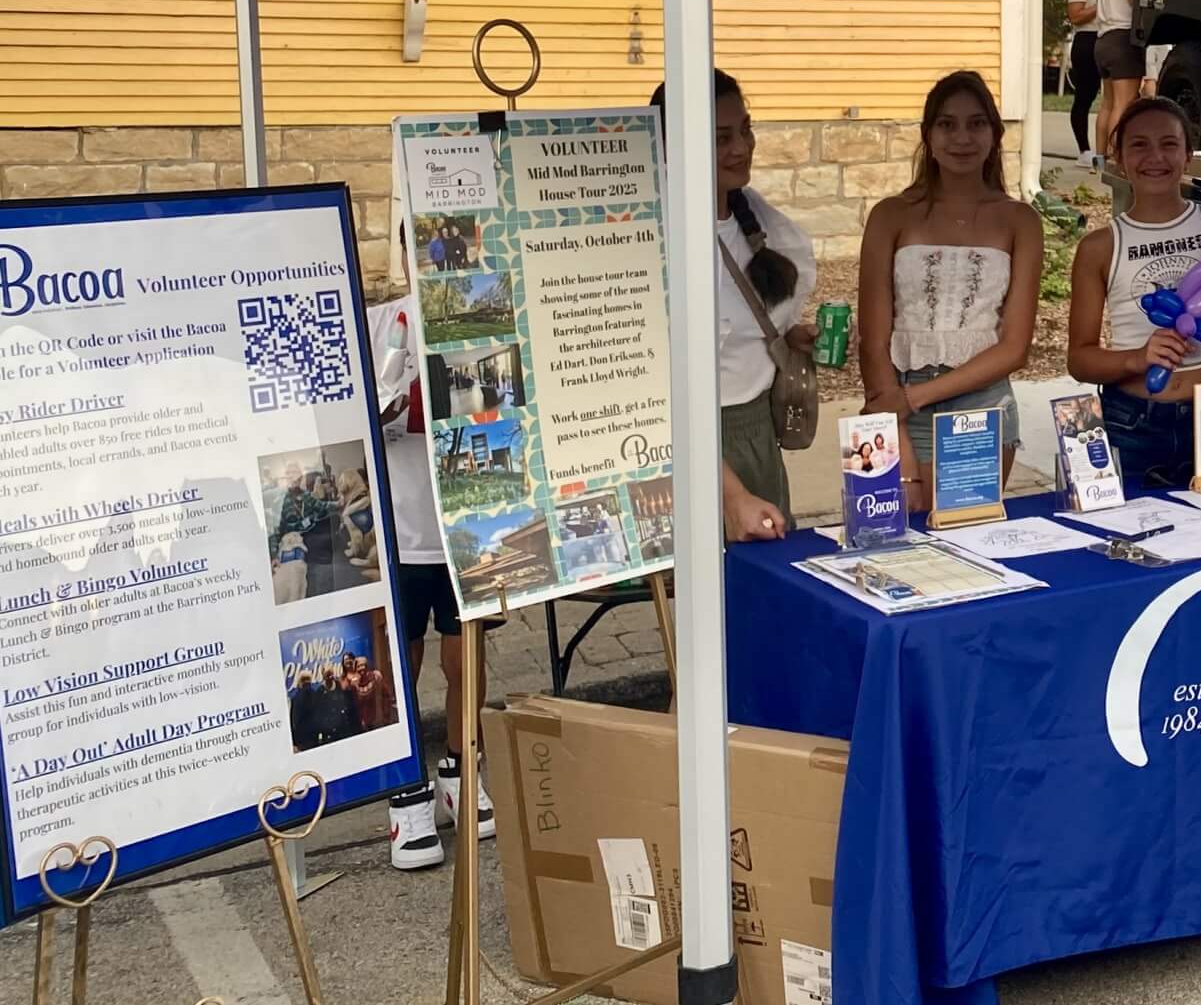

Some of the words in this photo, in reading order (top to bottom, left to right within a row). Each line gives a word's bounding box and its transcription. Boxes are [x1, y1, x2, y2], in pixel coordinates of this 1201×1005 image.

[425, 146, 480, 155] VOLUNTEER
[541, 139, 628, 157] VOLUNTEER
[528, 168, 550, 180] Mid
[553, 165, 577, 179] Mod
[580, 163, 645, 178] Barrington
[426, 189, 450, 200] MID
[458, 187, 486, 197] MOD
[539, 188, 576, 202] House
[578, 186, 607, 199] Tour
[609, 183, 638, 196] 2025
[525, 237, 583, 253] Saturday,
[585, 232, 632, 246] October
[635, 229, 654, 242] 4th
[0, 244, 125, 317] Bacoa
[137, 273, 226, 295] Volunteer
[231, 261, 345, 287] Opportunities
[540, 277, 560, 288] Join
[561, 275, 576, 285] the
[577, 274, 604, 284] house
[605, 272, 624, 282] tour
[626, 269, 648, 279] team
[540, 293, 579, 305] showing
[579, 289, 602, 299] some
[604, 286, 615, 296] of
[614, 286, 628, 296] the
[630, 283, 650, 293] most
[553, 306, 603, 320] fascinating
[604, 303, 632, 314] homes
[633, 301, 642, 309] in
[10, 342, 34, 357] the
[38, 339, 62, 355] QR
[67, 333, 104, 350] Code
[108, 333, 123, 345] or
[127, 328, 156, 343] visit
[161, 323, 183, 338] the
[187, 321, 226, 336] Bacoa
[553, 322, 603, 337] Barrington
[605, 317, 646, 331] featuring
[560, 343, 574, 353] the
[576, 336, 631, 351] architecture
[632, 332, 642, 342] of
[550, 361, 562, 372] Ed
[589, 355, 608, 366] Don
[647, 348, 655, 359] &
[560, 375, 588, 388] Frank
[590, 369, 614, 384] Lloyd
[19, 401, 66, 419] Rider
[71, 394, 124, 412] Driver
[551, 411, 579, 424] Work
[580, 409, 597, 420] one
[624, 401, 638, 413] get
[640, 401, 646, 409] a
[648, 396, 666, 407] free
[557, 432, 579, 445] pass
[580, 428, 590, 439] to
[591, 426, 607, 436] see
[608, 421, 633, 432] these
[634, 416, 667, 429] homes.
[550, 466, 580, 480] Funds
[581, 458, 615, 474] benefit
[42, 506, 79, 525] with
[83, 495, 143, 517] Wheels
[147, 487, 198, 506] Driver
[0, 588, 50, 612] Lunch
[56, 582, 71, 598] &
[77, 575, 126, 595] Bingo
[130, 557, 208, 581] Volunteer
[0, 611, 48, 630] Connect
[50, 602, 77, 617] with
[80, 597, 110, 613] older
[113, 589, 147, 606] adults
[150, 586, 160, 596] at
[163, 578, 203, 595] Bacoa's
[204, 567, 241, 584] weekly
[1, 631, 37, 649] Lunch
[40, 628, 51, 639] &
[55, 621, 88, 637] Bingo
[92, 609, 140, 630] program
[144, 606, 154, 617] at
[157, 601, 174, 613] the
[177, 587, 234, 609] Barrington
[237, 581, 260, 596] Park
[4, 685, 40, 705] Low
[45, 671, 98, 693] Vision
[103, 652, 168, 679] Support
[174, 641, 225, 662] Group
[5, 705, 41, 724] Assist
[44, 699, 65, 714] this
[68, 694, 88, 709] fun
[90, 686, 112, 701] and
[115, 673, 174, 696] interactive
[177, 660, 220, 680] monthly
[224, 649, 264, 669] support
[8, 726, 43, 745] group
[46, 719, 63, 733] for
[67, 702, 129, 727] individuals
[132, 693, 157, 710] with
[35, 755, 67, 774] Day
[112, 728, 157, 750] Adult
[163, 721, 193, 740] Day
[198, 701, 266, 729] Program
[15, 786, 43, 802] Help
[47, 766, 110, 789] individuals
[113, 757, 138, 774] with
[141, 743, 193, 766] dementia
[195, 730, 238, 751] through
[241, 719, 282, 738] creative
[529, 741, 562, 832] Blinko
